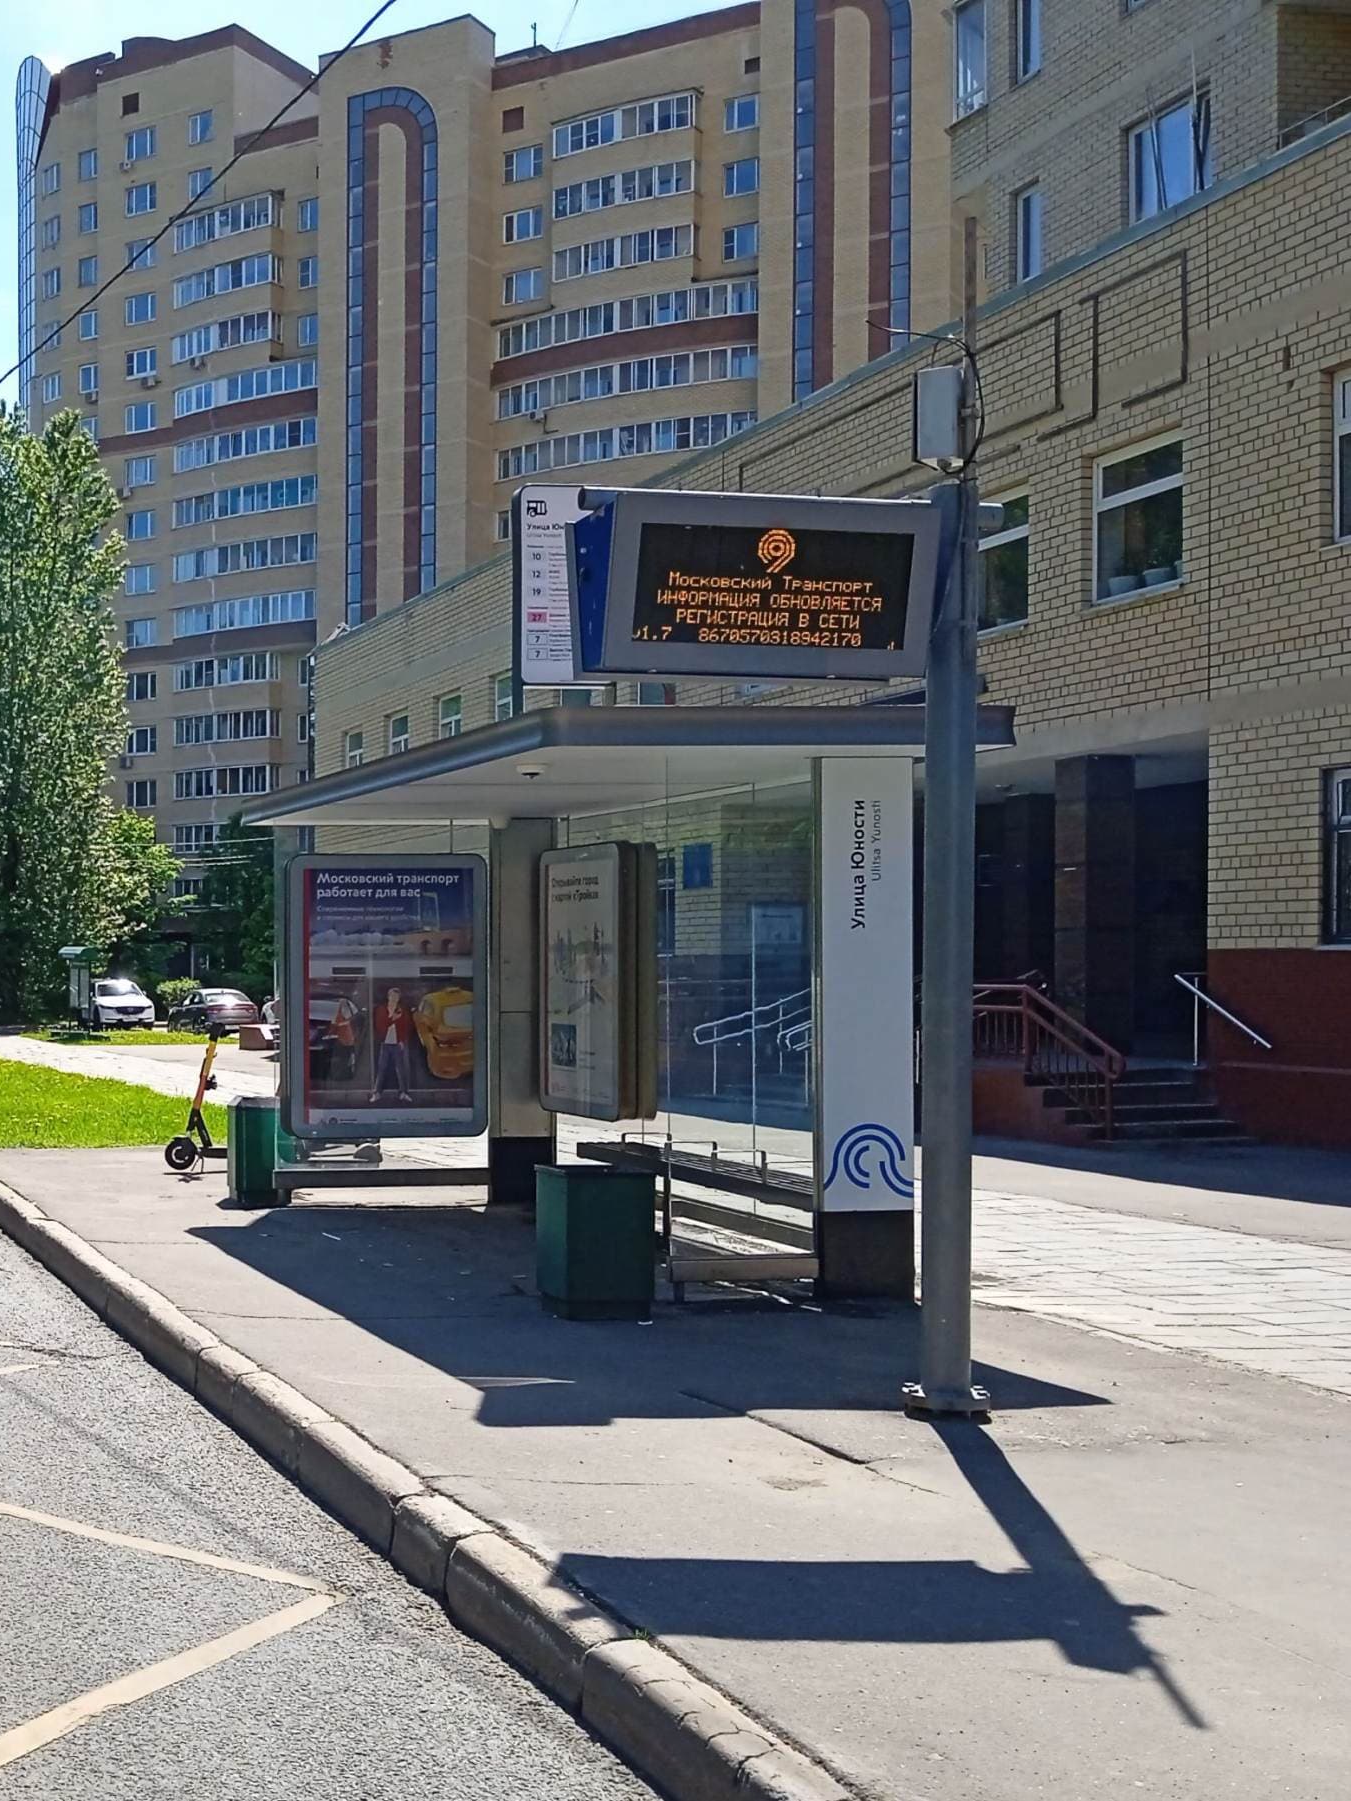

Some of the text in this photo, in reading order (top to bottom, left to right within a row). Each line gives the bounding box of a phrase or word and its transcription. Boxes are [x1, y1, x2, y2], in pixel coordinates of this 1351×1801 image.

[527, 523, 550, 531] Улица
[532, 553, 541, 561] 10
[532, 570, 541, 578] 12
[668, 571, 874, 593] Московский Транспорт
[532, 588, 541, 596] 19
[656, 589, 882, 612] ИНФОРМАЦИЯ ОБНОВЛЯЕТСЯ
[532, 614, 542, 622] 27
[675, 609, 860, 629] РЕГИСТРАЦИЯ В СЕТИ
[698, 627, 862, 647] 8670570318942170
[870, 799, 882, 882] Ulitsa Yunosti
[850, 799, 867, 930] Улица Юности
[316, 873, 460, 886] Московский транспорт
[316, 887, 421, 899] работает для вас
